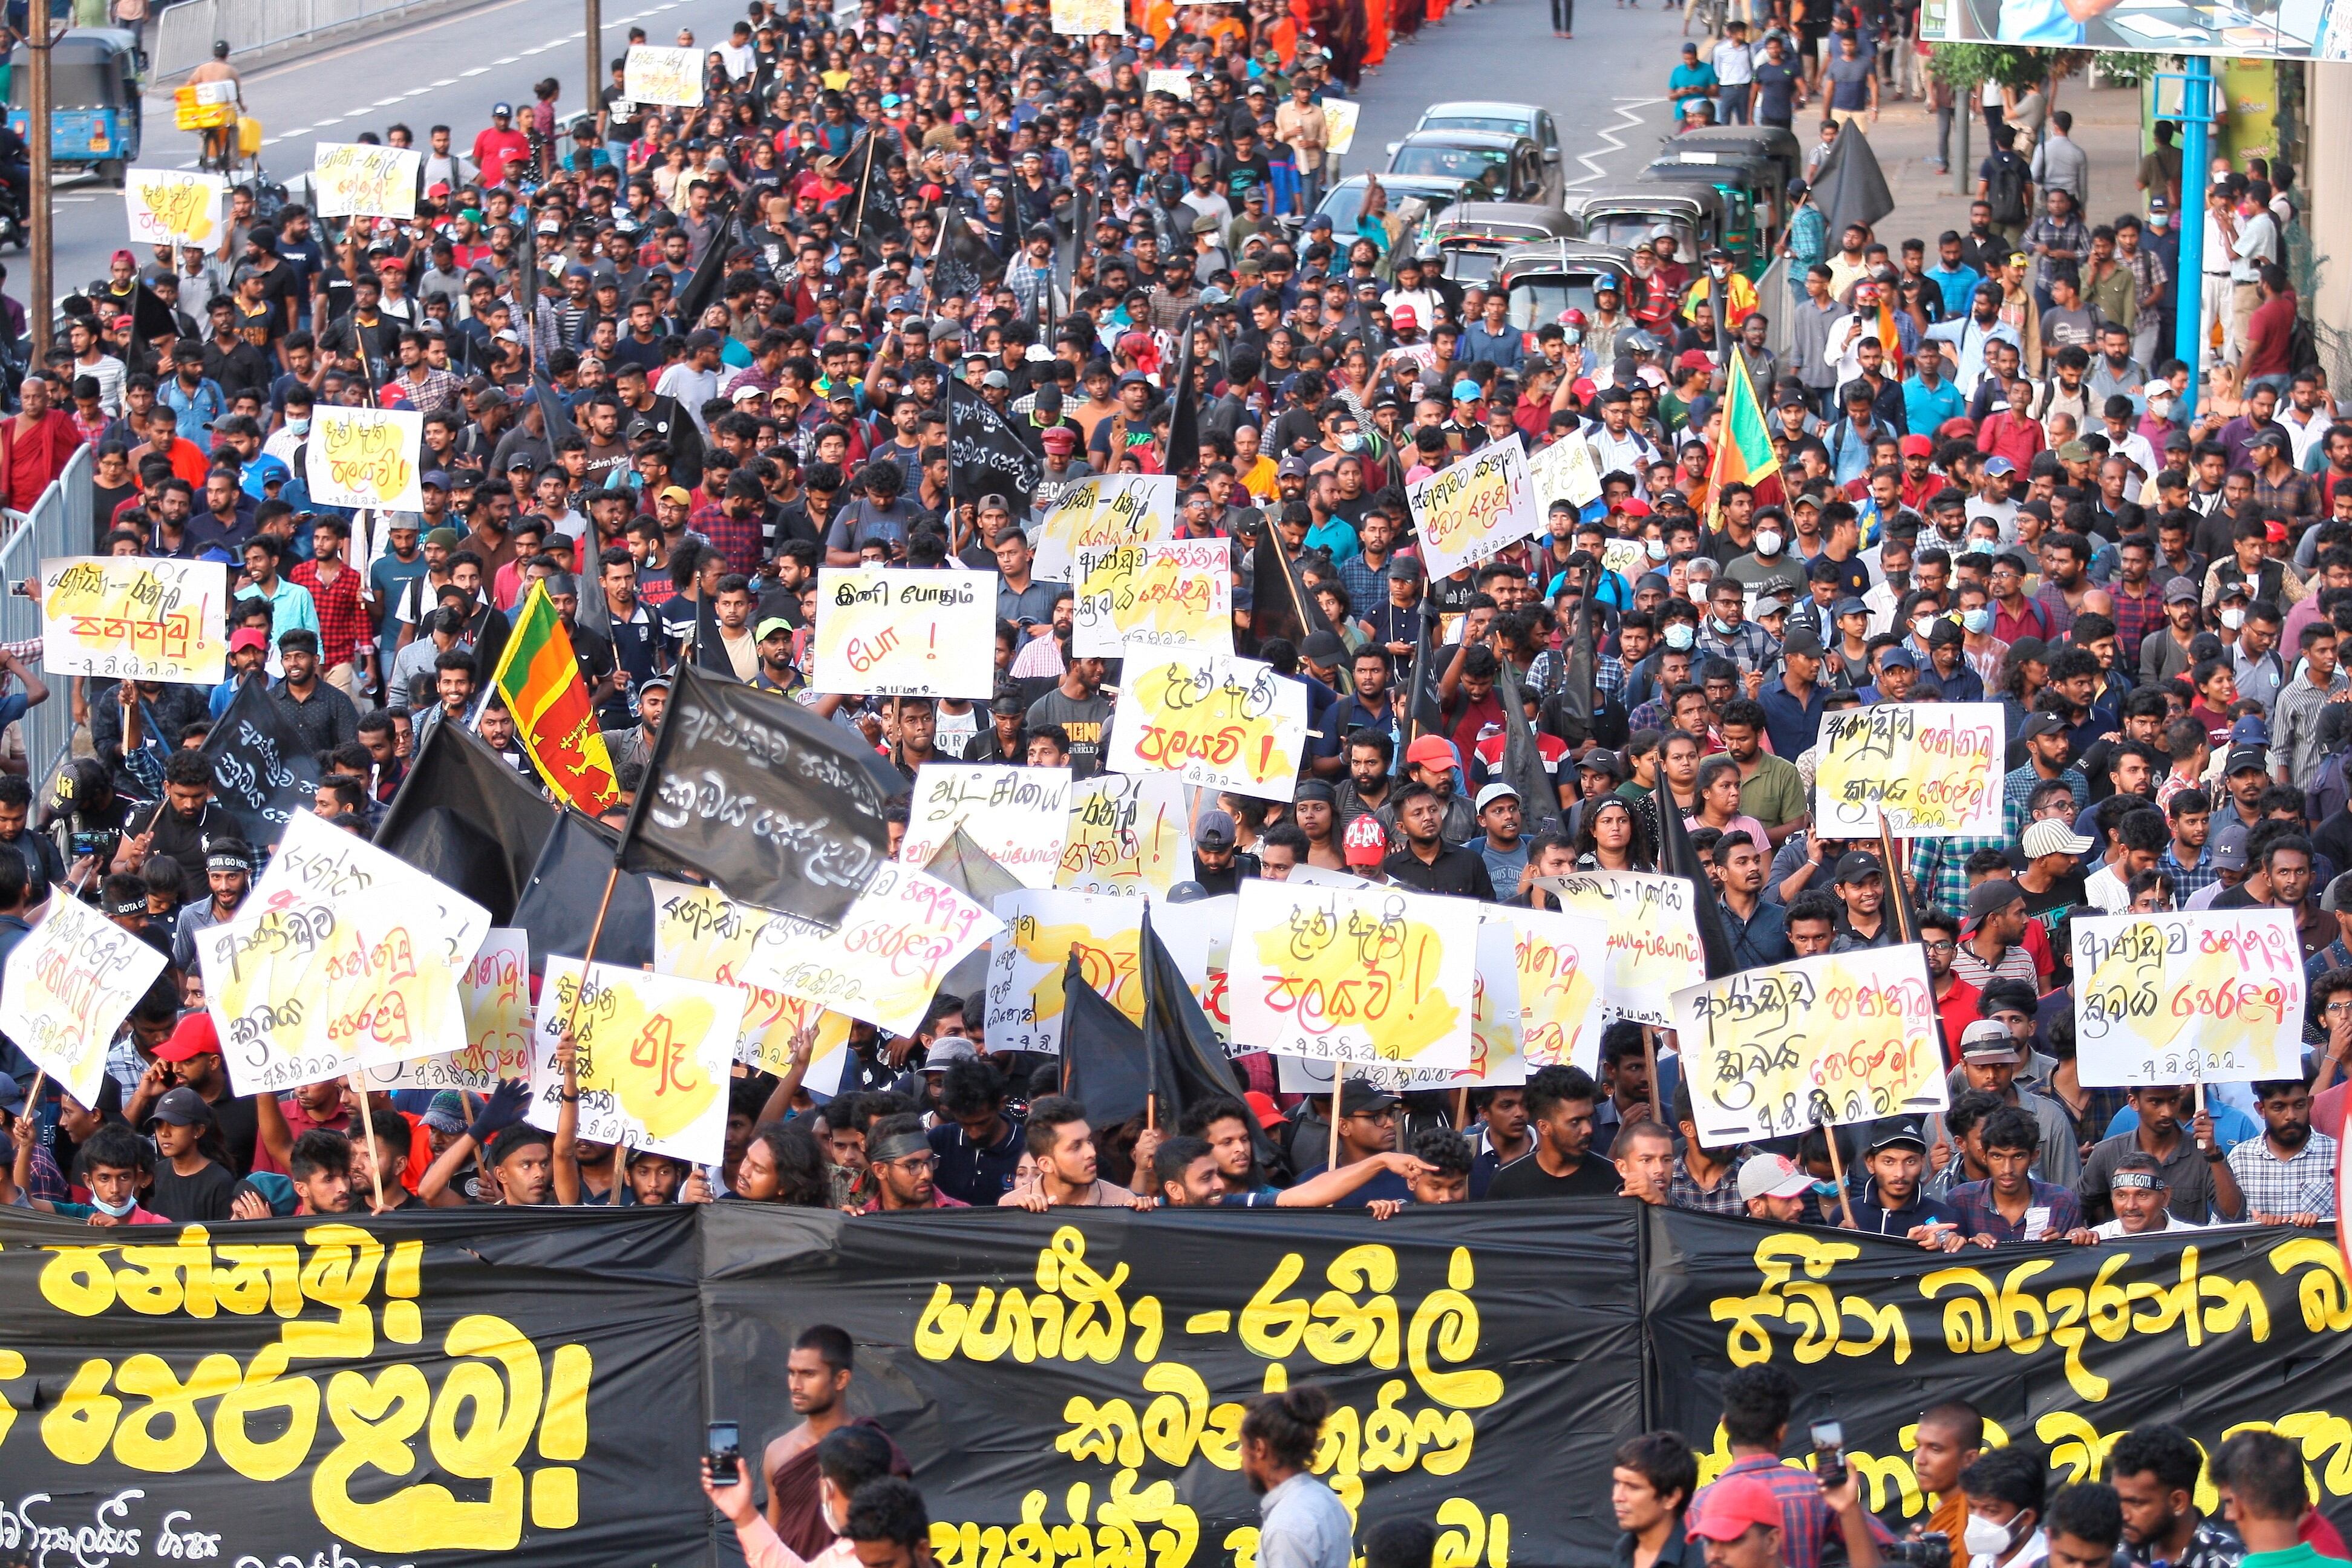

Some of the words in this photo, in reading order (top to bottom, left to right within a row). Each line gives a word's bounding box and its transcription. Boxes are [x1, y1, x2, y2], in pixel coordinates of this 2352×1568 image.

[835, 581, 889, 606] இனி
[901, 581, 974, 606] போதும்
[846, 626, 900, 672] போ
[118, 902, 137, 913] GOTA
